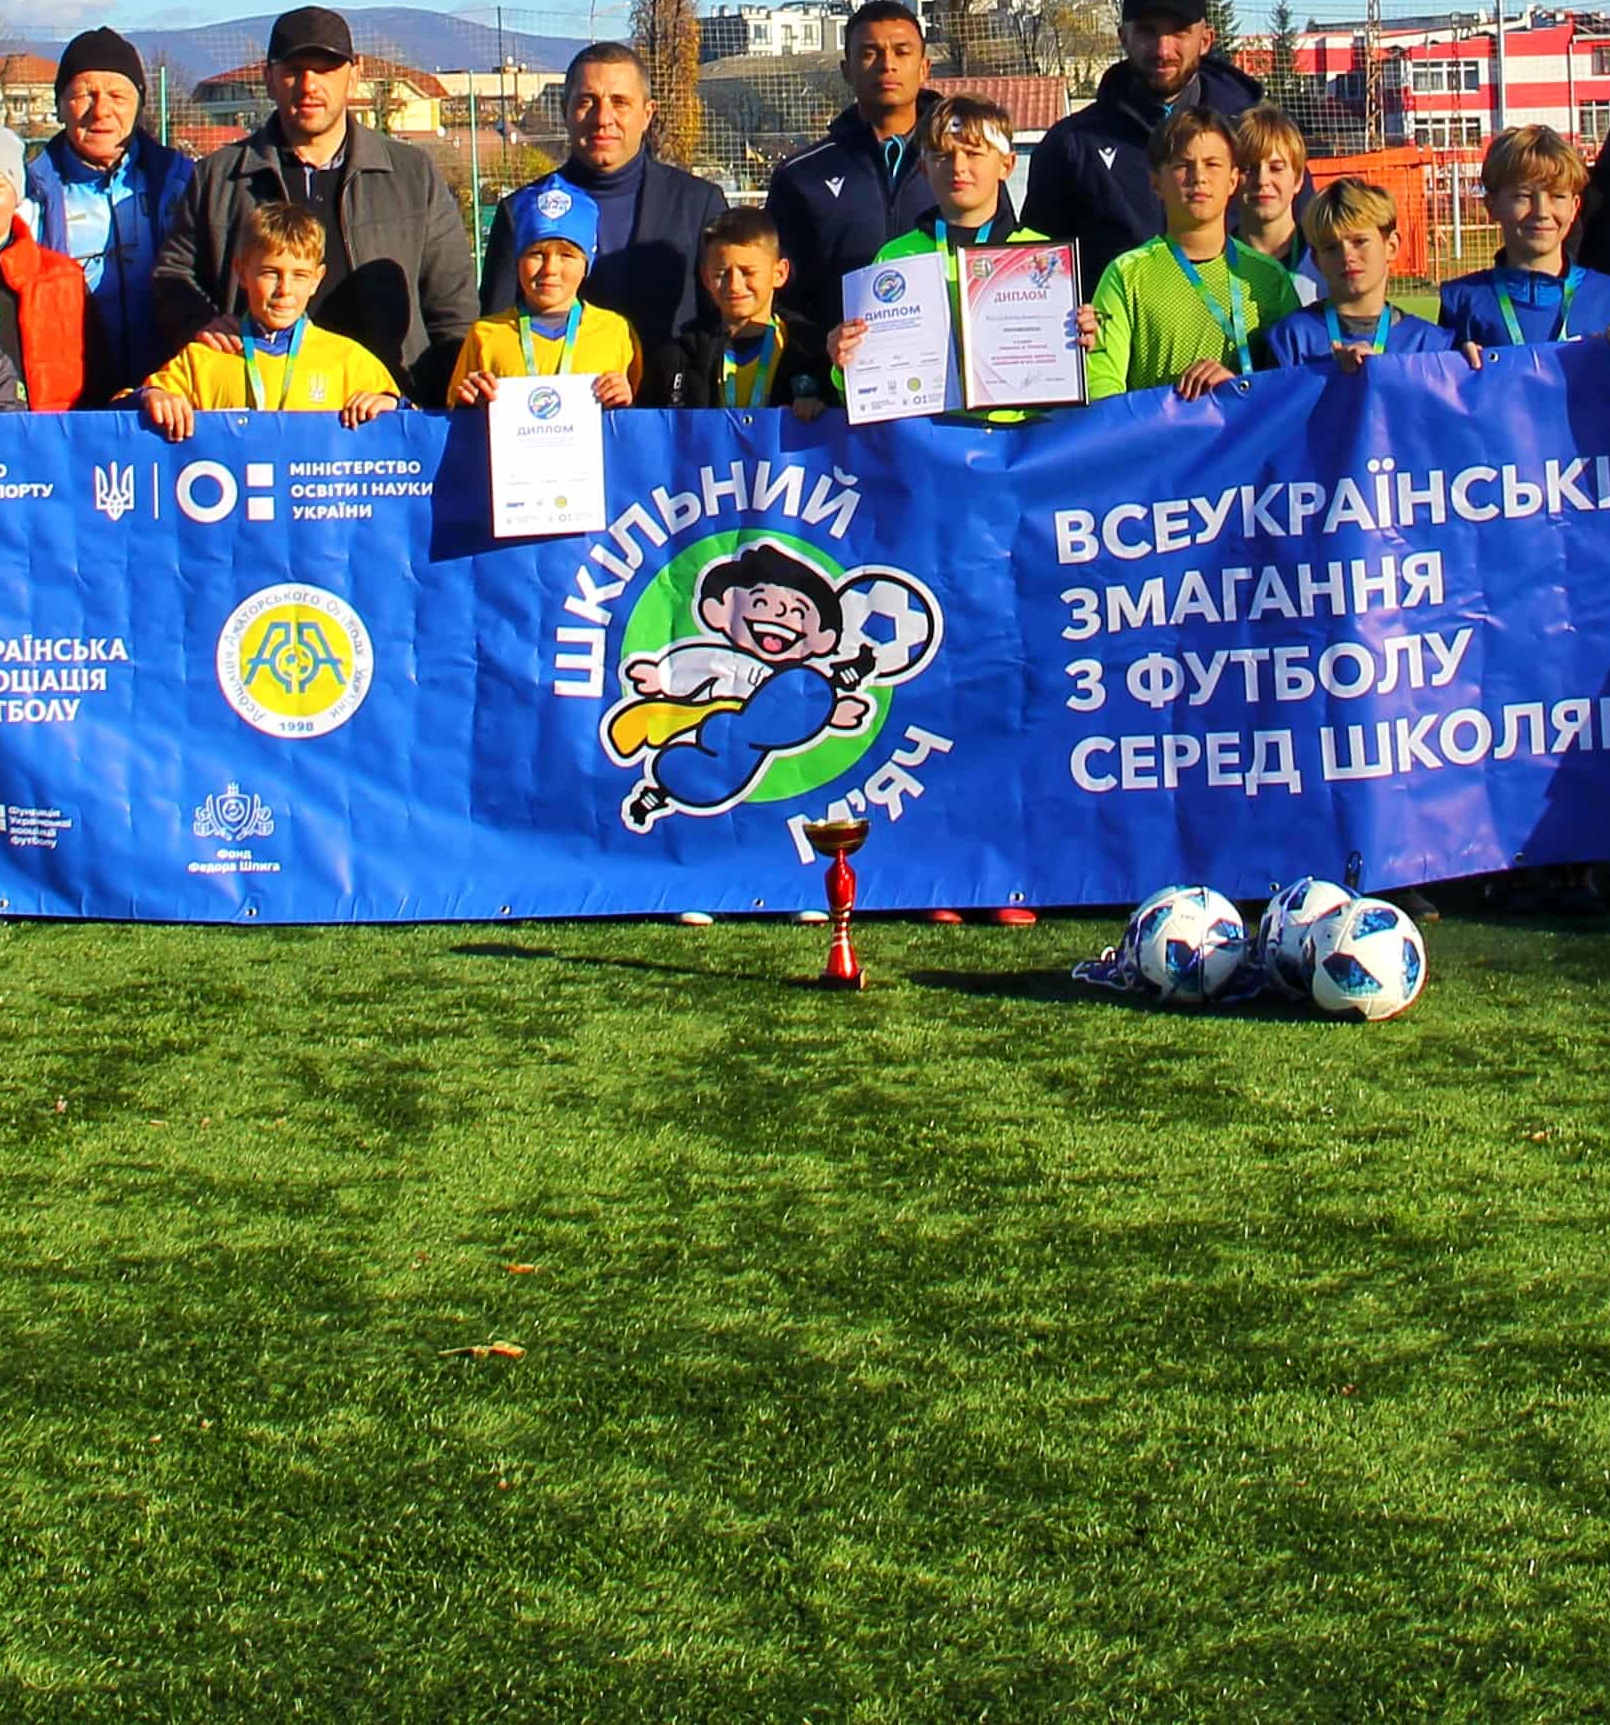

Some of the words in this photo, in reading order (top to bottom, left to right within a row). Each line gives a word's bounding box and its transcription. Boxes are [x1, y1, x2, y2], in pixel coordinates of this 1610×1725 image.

[994, 289, 1048, 303] ДИПЛОМ
[864, 305, 922, 322] ДИПЛОМ
[516, 424, 574, 437] ДИПЛОМ
[289, 460, 422, 476] МІНІСТЕРСТВО
[290, 482, 358, 498] ОСВІТИ
[362, 482, 368, 496] І
[371, 481, 435, 497] НАУКИ
[292, 501, 374, 520] УКРАЇНИ
[553, 458, 864, 699] ШКІЛЬНИЙ
[1059, 549, 1446, 642] ЗМАГАННЯ
[1064, 657, 1108, 713] З
[1125, 627, 1475, 711] ФУТБОЛУ
[278, 721, 315, 732] 1998
[1069, 728, 1303, 798] СЕРЕД
